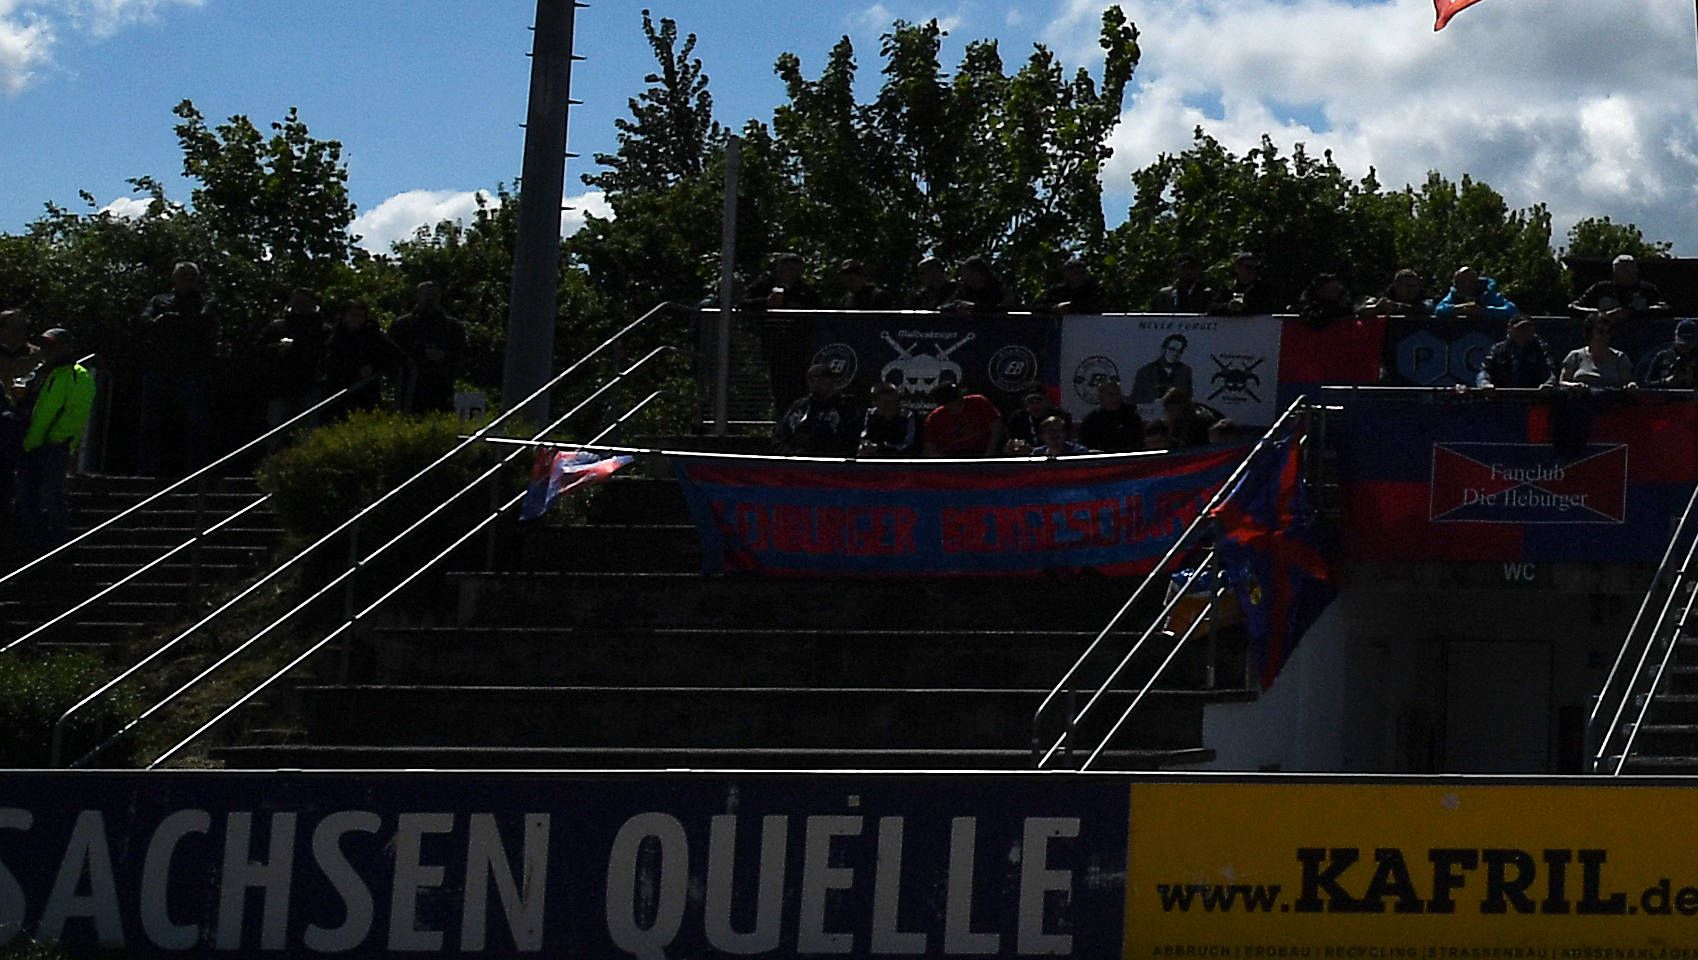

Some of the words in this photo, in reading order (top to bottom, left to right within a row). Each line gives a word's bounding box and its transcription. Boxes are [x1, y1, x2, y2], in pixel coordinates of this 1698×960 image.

[1489, 463, 1566, 482] Fanclub
[1463, 487, 1497, 507] Die
[1503, 562, 1537, 582] WC
[605, 811, 1082, 960] QUELLE
[1151, 944, 1231, 959] ABBRUCH
[1324, 944, 1419, 960] RECYCLING
[1426, 945, 1548, 960] STRASSENBAU
